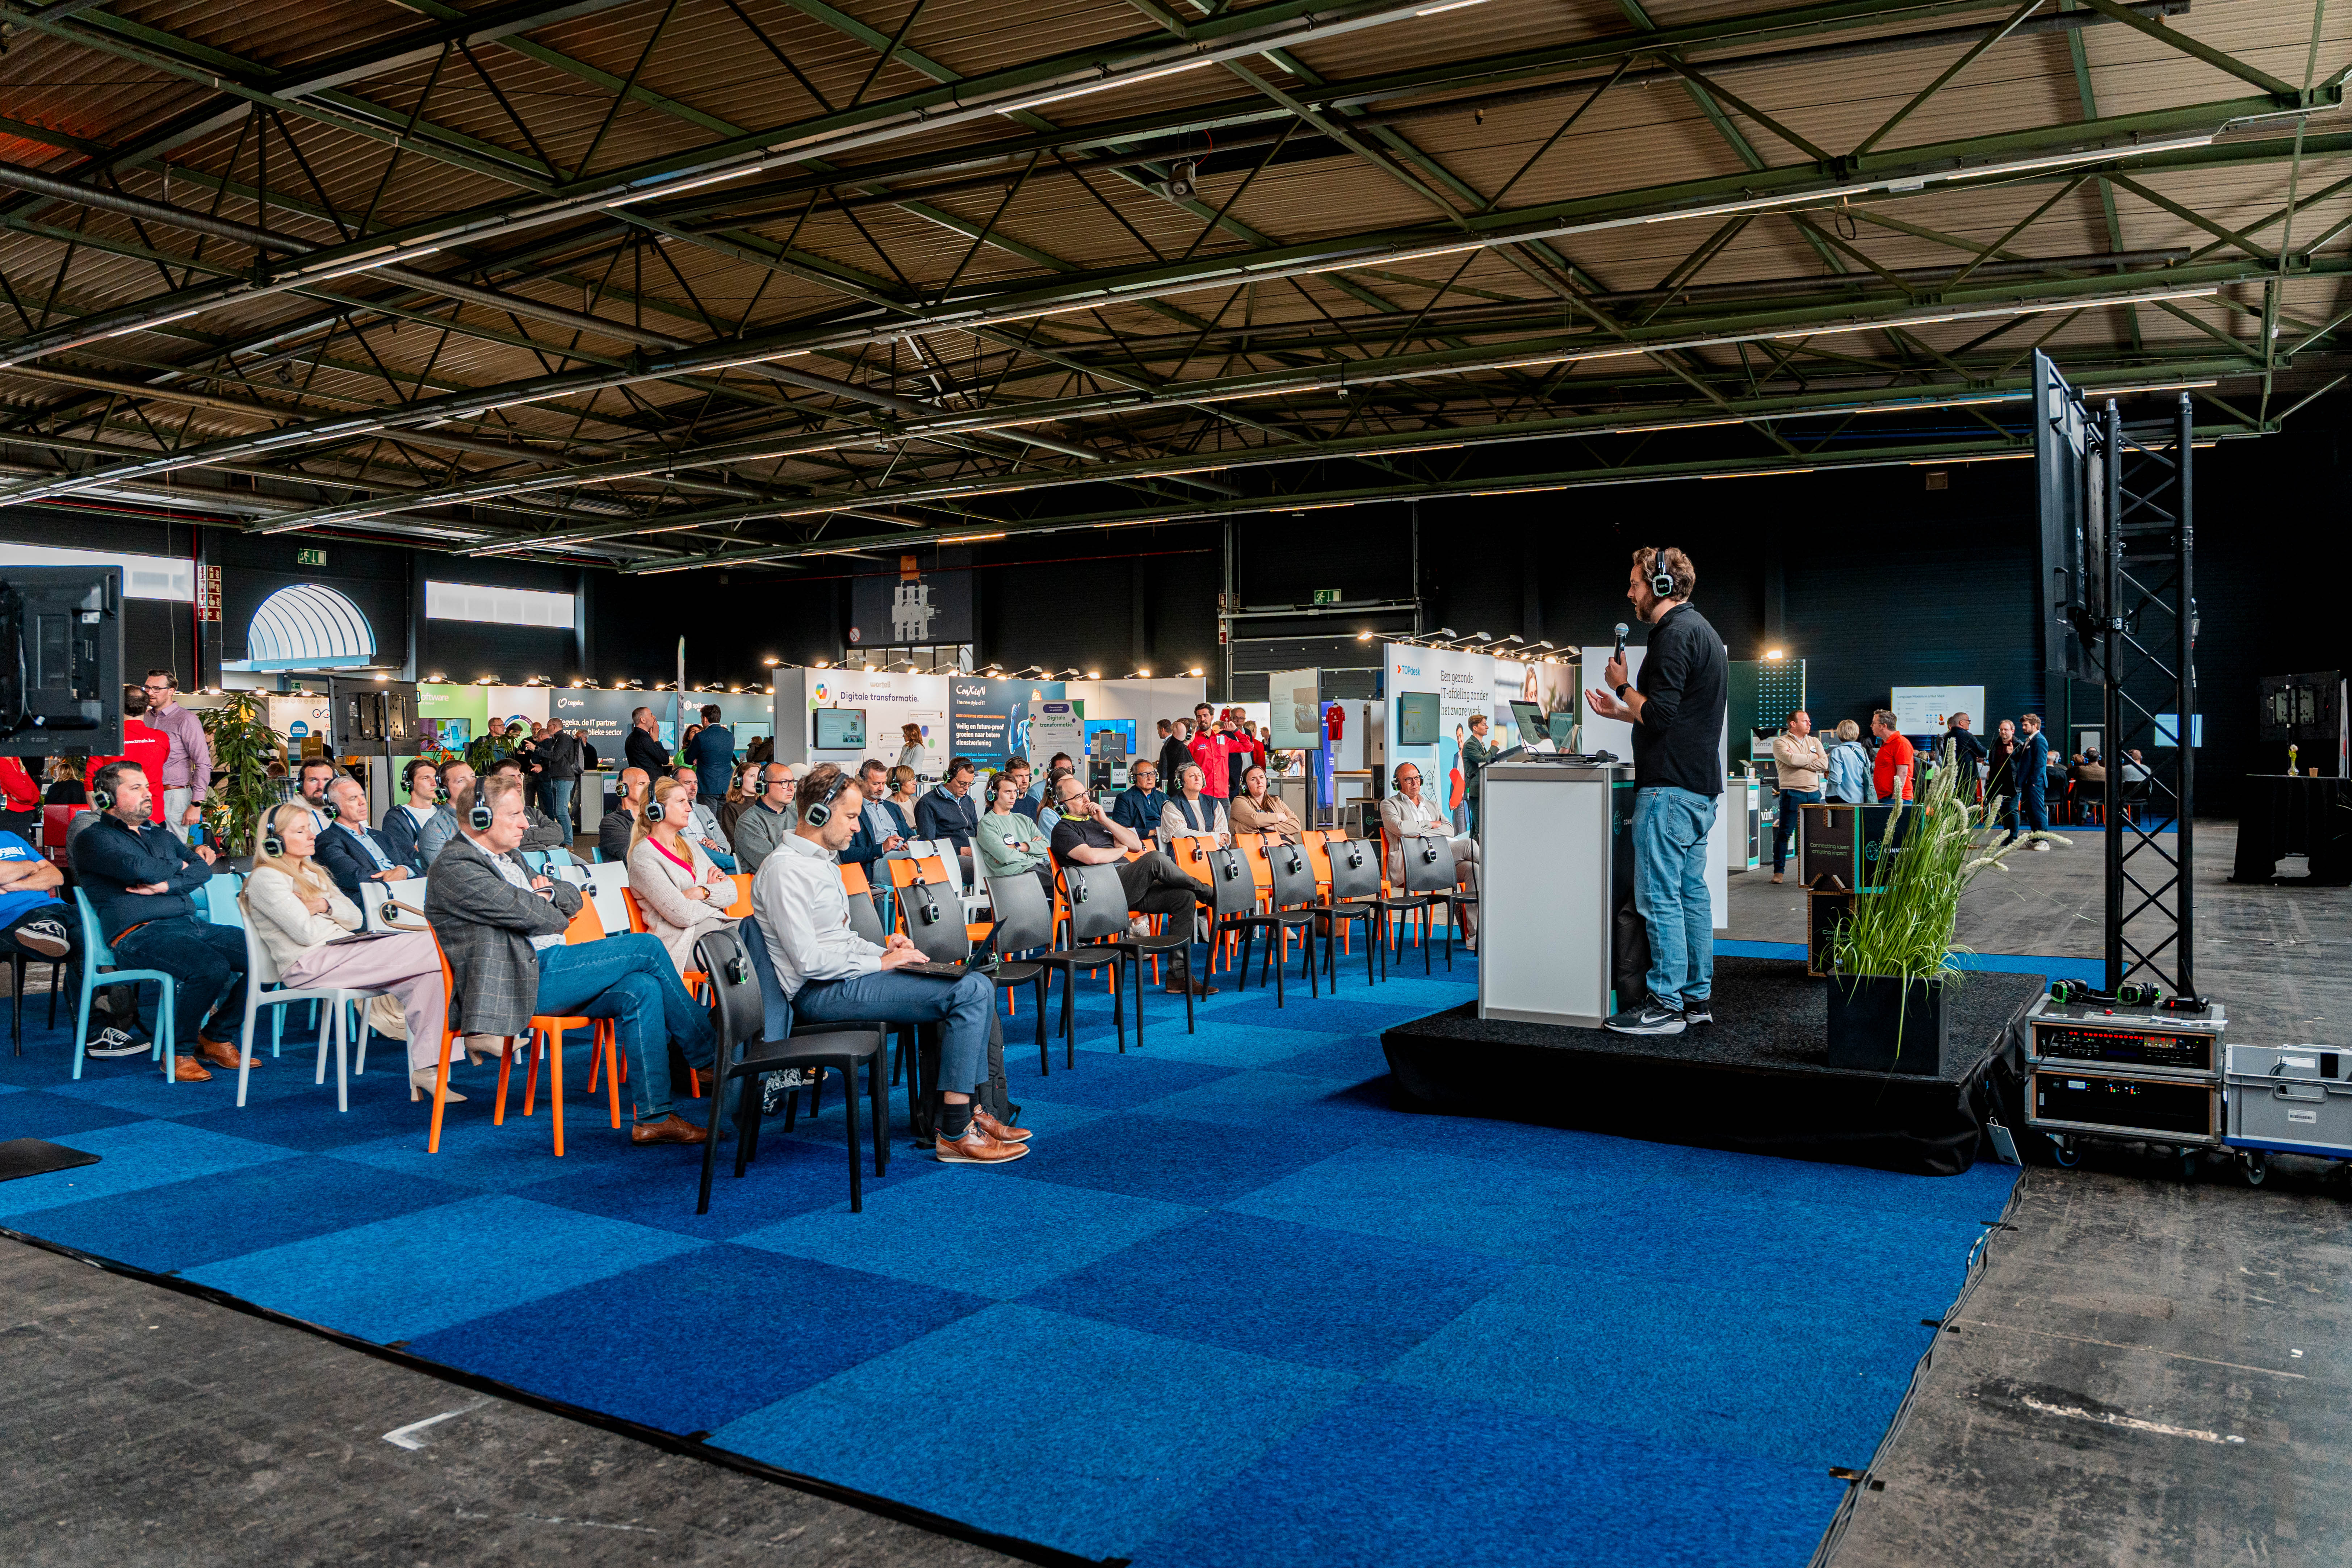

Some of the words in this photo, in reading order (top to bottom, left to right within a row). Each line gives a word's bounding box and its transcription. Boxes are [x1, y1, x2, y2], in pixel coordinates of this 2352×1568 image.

[1402, 665, 1421, 676] TOPdesk
[1441, 670, 1450, 682] Een
[1452, 672, 1473, 685] gezonde
[421, 692, 449, 701] oftware
[840, 691, 868, 702] Digitale
[870, 693, 919, 702] transformatie.
[1441, 687, 1470, 702] IT-afdeling
[1471, 690, 1488, 701] zonder
[1441, 704, 1450, 715] het
[1451, 708, 1467, 716] zware
[1468, 706, 1481, 716] werk
[596, 720, 617, 728] partner
